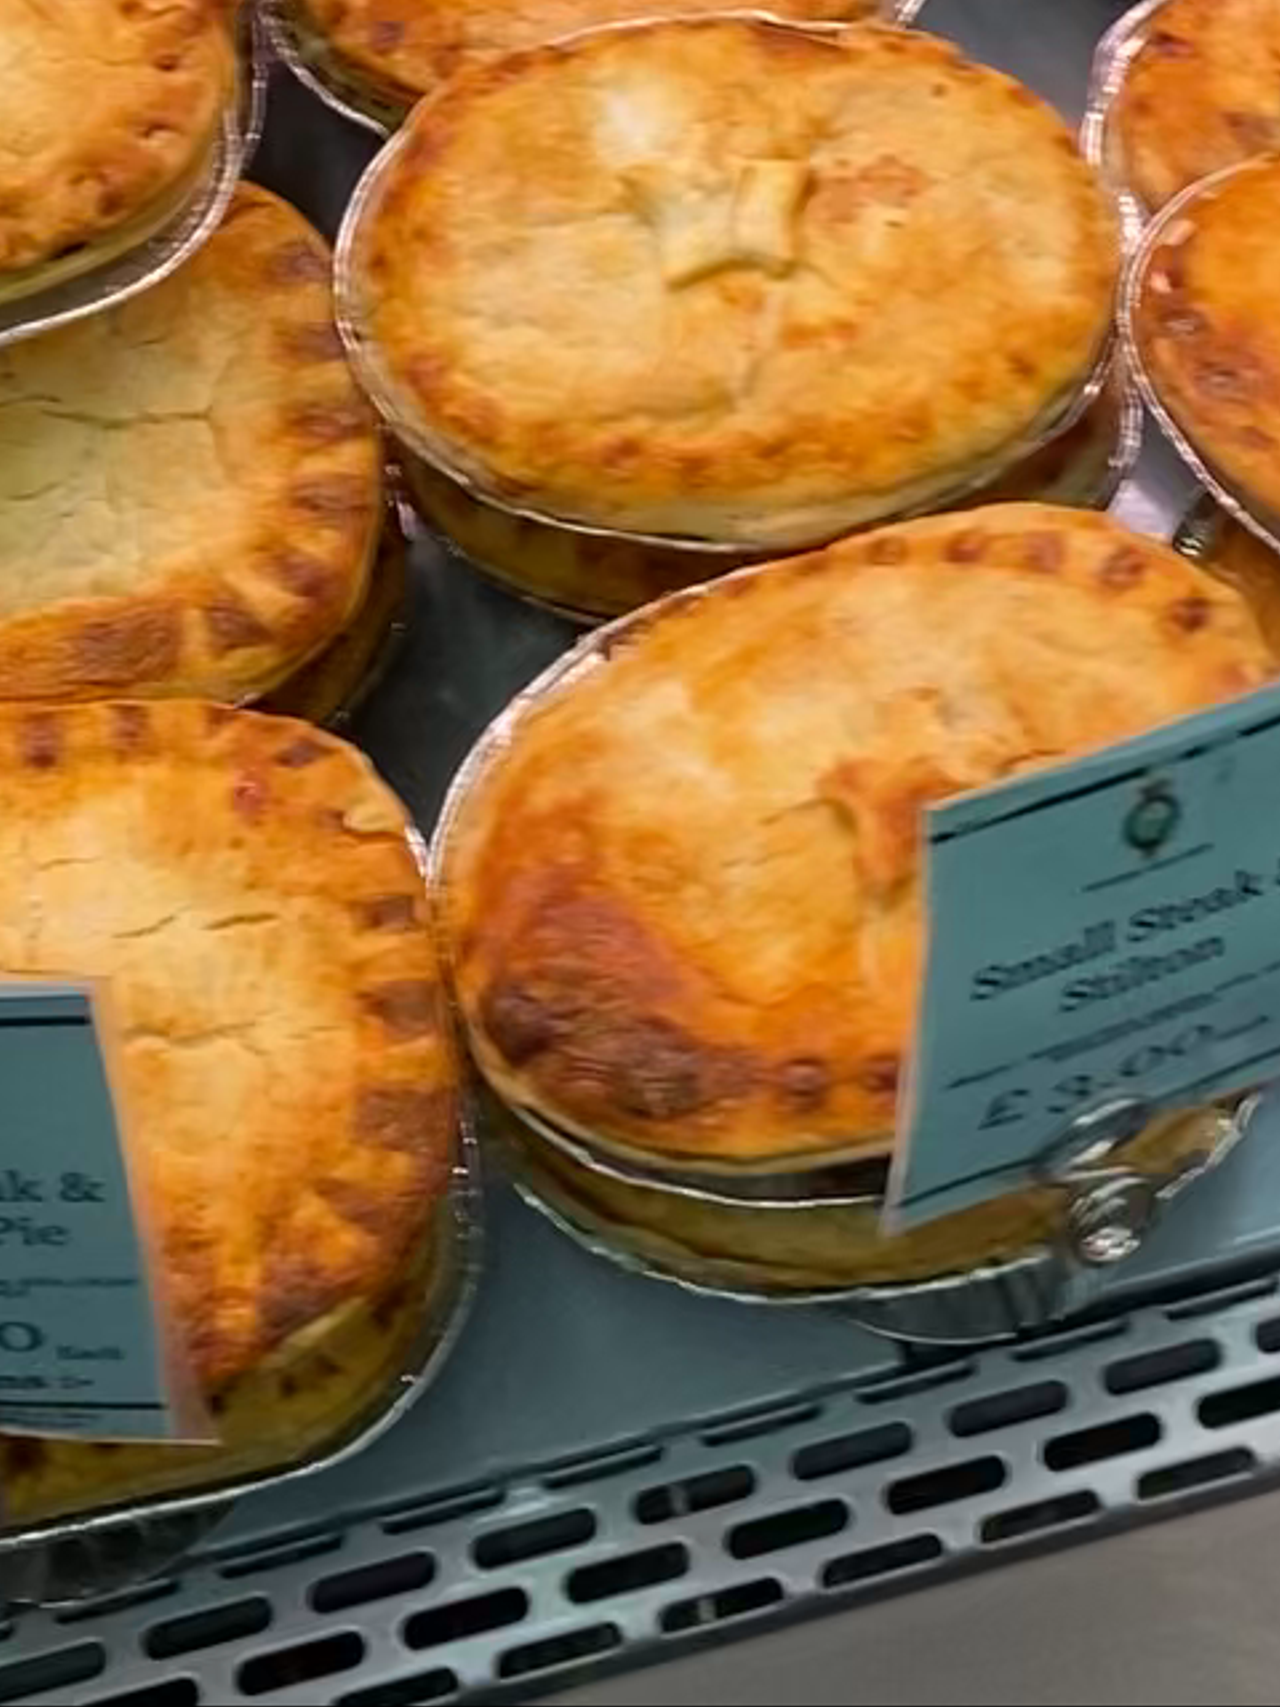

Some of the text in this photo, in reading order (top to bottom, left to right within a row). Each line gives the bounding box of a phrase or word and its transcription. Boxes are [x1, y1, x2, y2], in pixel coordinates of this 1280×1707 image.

[969, 921, 1118, 1001] Small
[1126, 868, 1263, 944] Steak
[1060, 935, 1226, 1013] Stilton
[59, 1172, 106, 1204] &
